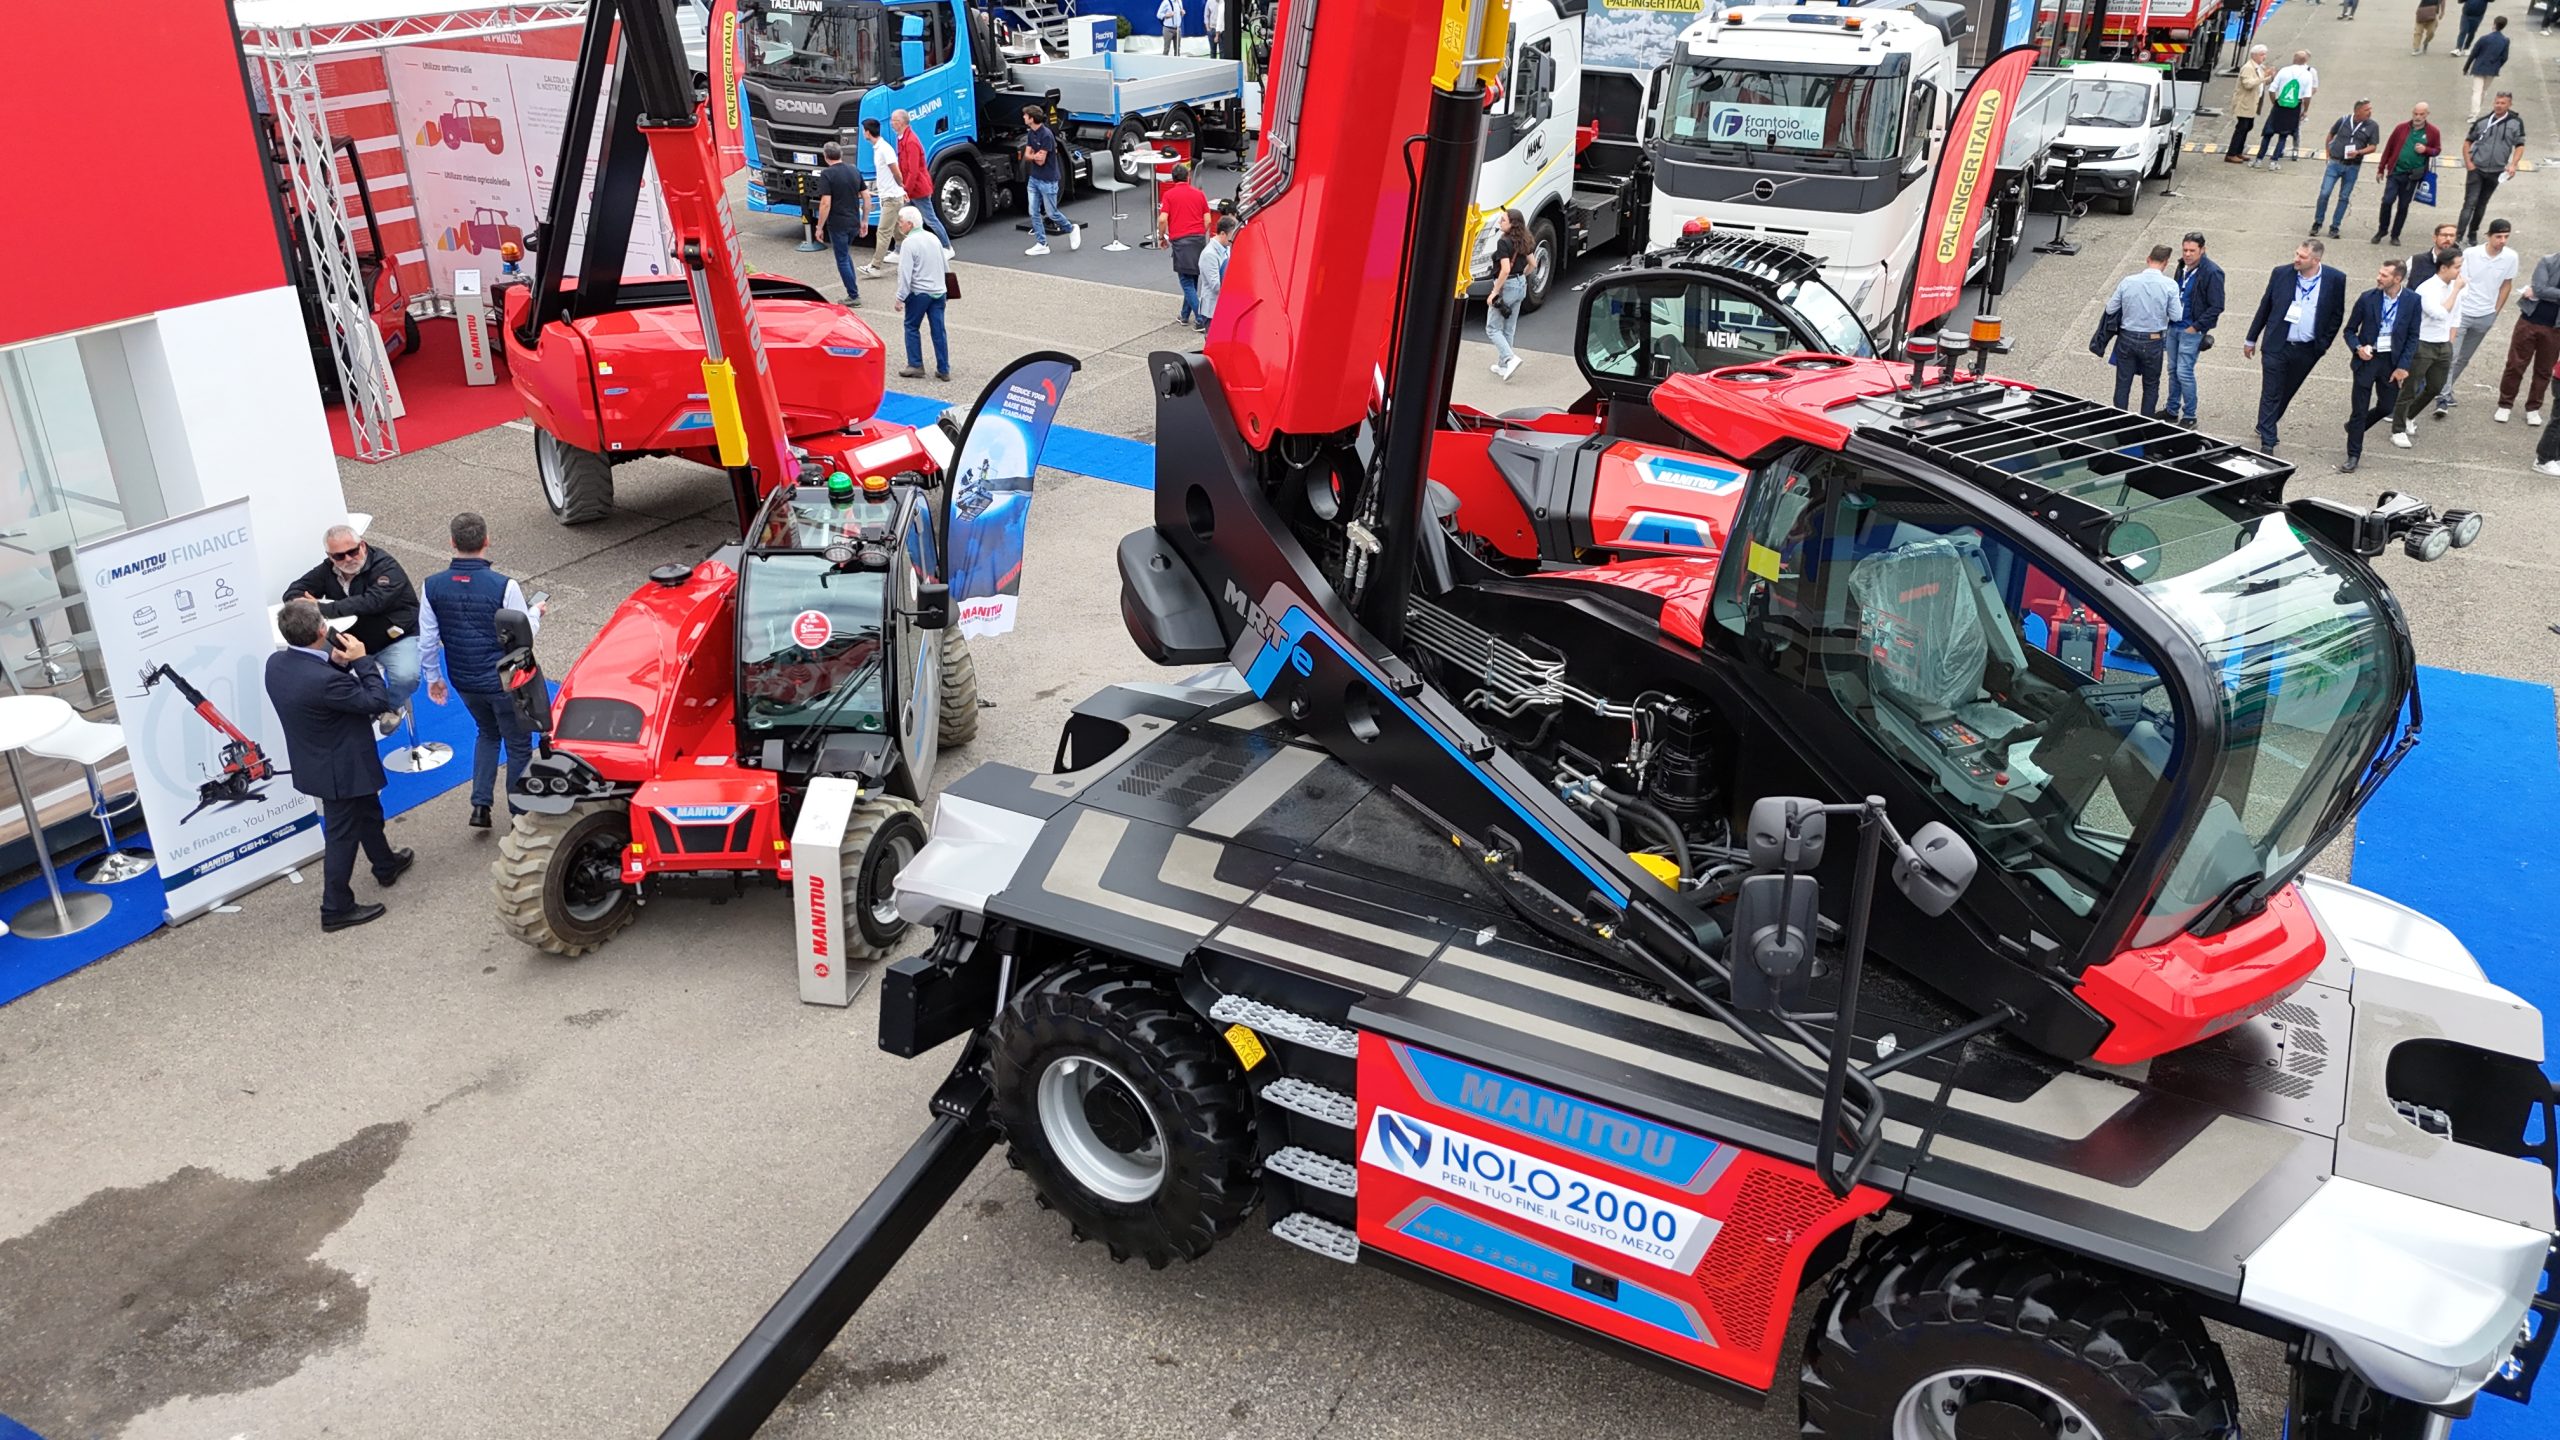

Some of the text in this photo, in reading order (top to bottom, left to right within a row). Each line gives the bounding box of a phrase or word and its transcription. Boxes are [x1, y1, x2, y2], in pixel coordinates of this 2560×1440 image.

[770, 0, 822, 12] TAGLIAVINI
[1667, 0, 1700, 10] ITALIA
[492, 30, 523, 45] PRATICA
[725, 16, 734, 54] ITALIA
[724, 57, 736, 125] PALFINGER
[774, 98, 828, 116] SCANIA
[909, 97, 943, 120] GLIAVINI
[1745, 114, 1800, 129] frantoio
[1745, 126, 1820, 141] fondovalle
[1968, 96, 1999, 154] ITALIA
[1939, 157, 1981, 257] PALFINGER
[716, 191, 768, 376] MANITOU
[466, 314, 482, 358] MANITOU
[1707, 331, 1740, 349] NEW
[1656, 470, 1719, 491] MANITOU
[111, 527, 249, 580] MANITOU FINANCE
[142, 563, 167, 576] GROUP
[677, 806, 729, 817] MANITOU
[169, 845, 192, 861] We
[193, 825, 242, 851] finance,
[243, 813, 265, 828] You
[239, 839, 269, 854] GEHL
[809, 875, 828, 957] MANITOU
[1460, 1072, 1676, 1167] MANITOU
[1443, 1136, 1677, 1243] NOLO 2000
[1442, 1171, 1466, 1189] PER
[1469, 1179, 1480, 1193] IL
[1483, 1185, 1513, 1204] TUO
[1550, 1206, 1561, 1222] IL
[1564, 1212, 1618, 1241] GIUSTO
[1621, 1234, 1676, 1261] MEZZO
